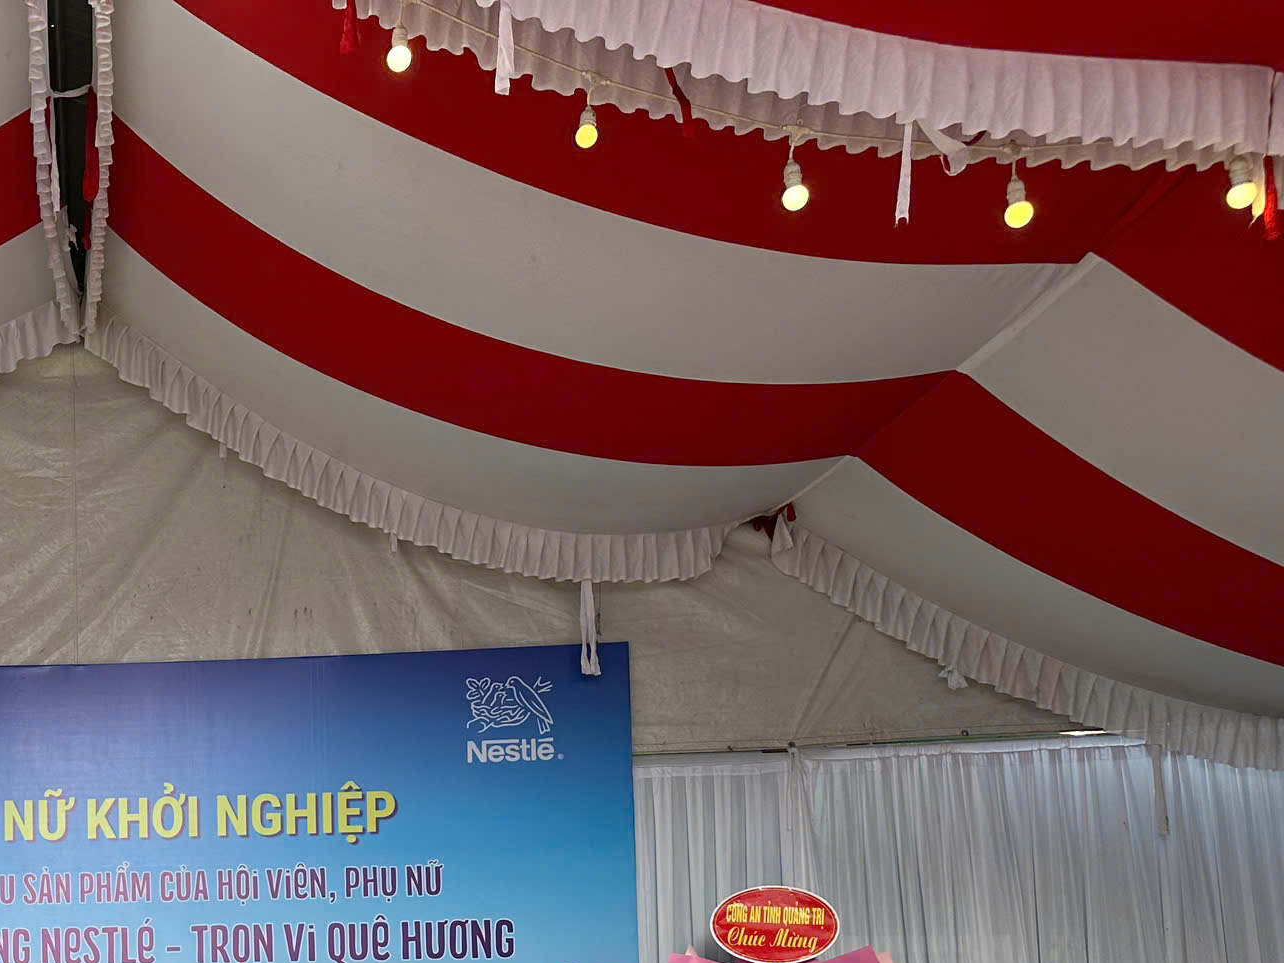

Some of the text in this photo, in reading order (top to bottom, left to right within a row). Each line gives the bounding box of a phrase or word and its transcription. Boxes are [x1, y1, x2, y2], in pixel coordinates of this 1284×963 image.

[4, 788, 77, 843] NỮ
[86, 782, 200, 840] KHỞI
[216, 780, 398, 845] NGHIỆP
[23, 866, 72, 905] SẢN
[79, 861, 151, 904] PHẨM
[159, 864, 210, 902] CỦA
[344, 864, 399, 902] PHỤ
[405, 859, 444, 897] NỮ
[725, 900, 825, 930] CÔNG AN TỈNH QUẢNG TRỊ
[400, 917, 516, 962] HƯƠNG
[727, 926, 819, 953] Chúc Mừng
